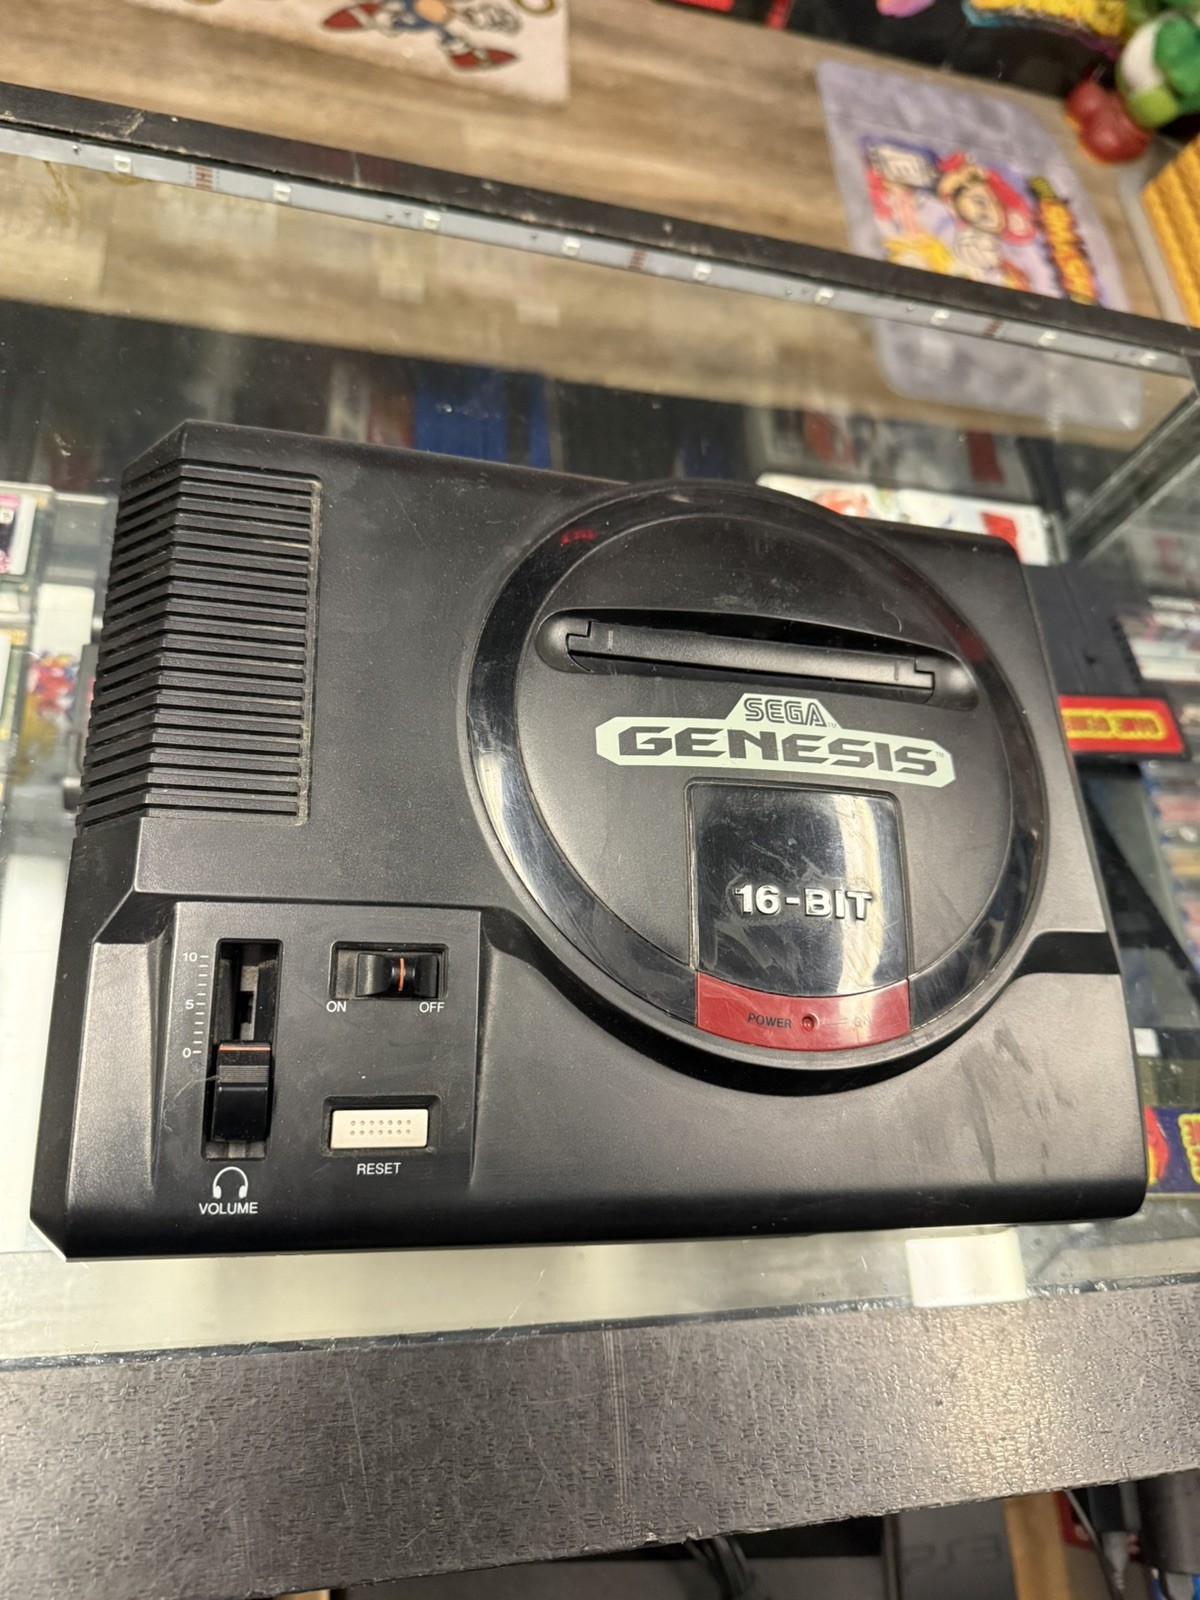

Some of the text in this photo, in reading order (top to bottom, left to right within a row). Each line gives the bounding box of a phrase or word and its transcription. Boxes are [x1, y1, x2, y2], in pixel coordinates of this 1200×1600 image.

[743, 698, 827, 727] SEGA
[618, 726, 937, 777] GENESIS
[734, 884, 873, 920] 16-BIT
[182, 952, 198, 962] 10
[185, 999, 194, 1009] 5
[326, 1001, 445, 1013] ON OFF
[747, 1013, 792, 1029] POWER
[182, 1047, 192, 1058] 0
[356, 1162, 402, 1175] RESET
[198, 1201, 259, 1215] VOLUME
